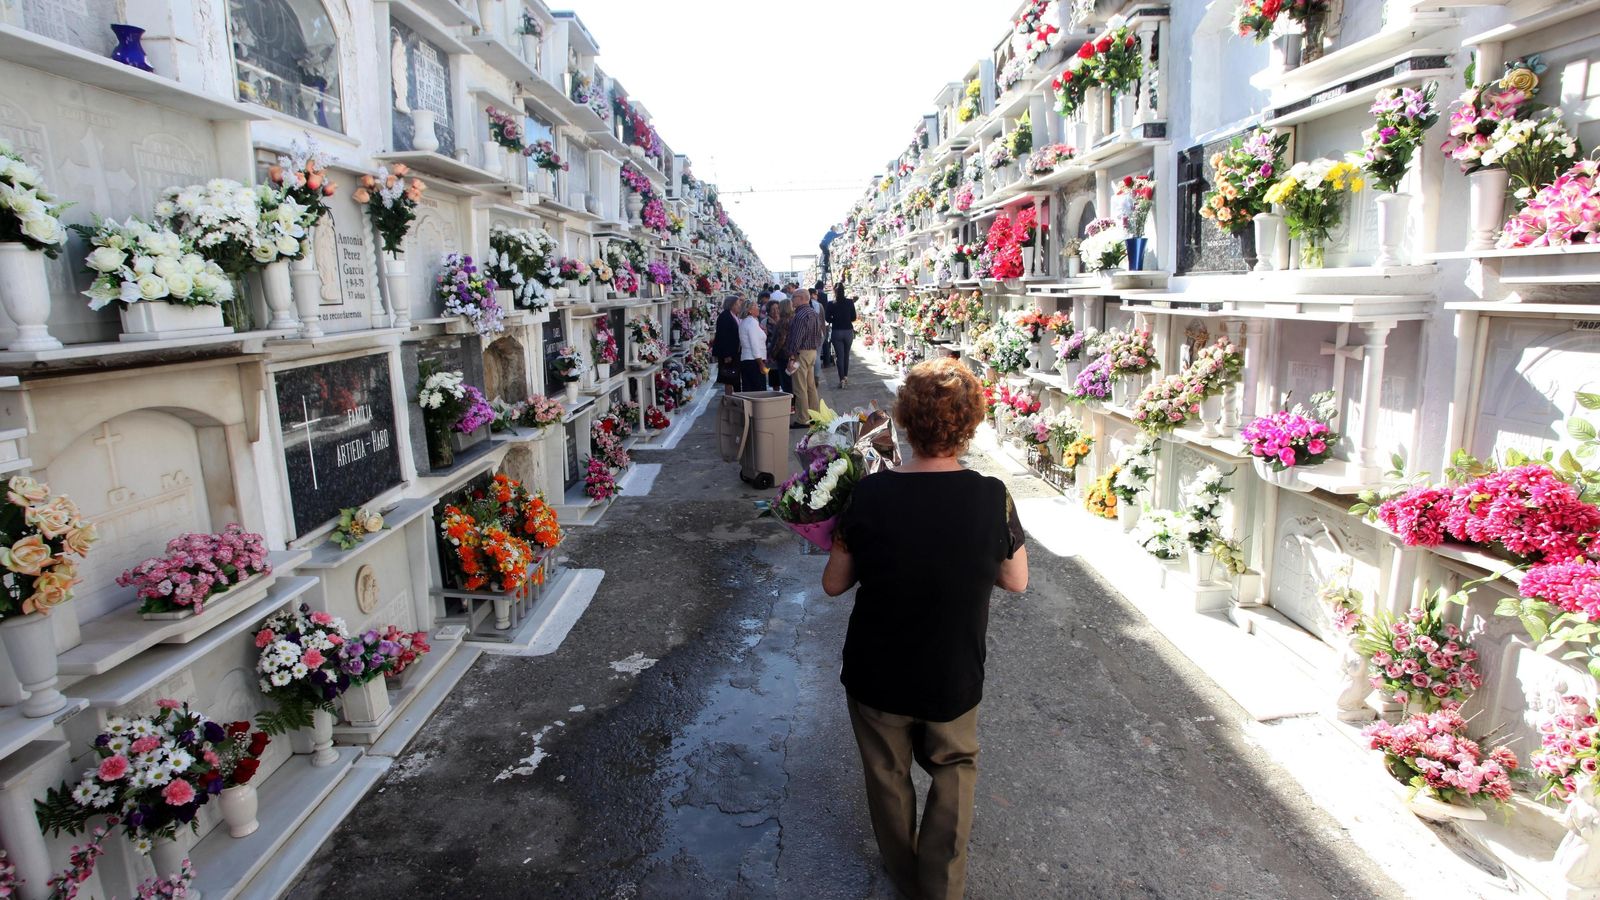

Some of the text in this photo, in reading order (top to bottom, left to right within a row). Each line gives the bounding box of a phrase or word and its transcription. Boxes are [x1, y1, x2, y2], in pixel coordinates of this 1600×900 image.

[337, 232, 363, 246] Antonia
[336, 438, 367, 468] ARTIEDA
[371, 428, 390, 453] HARO
